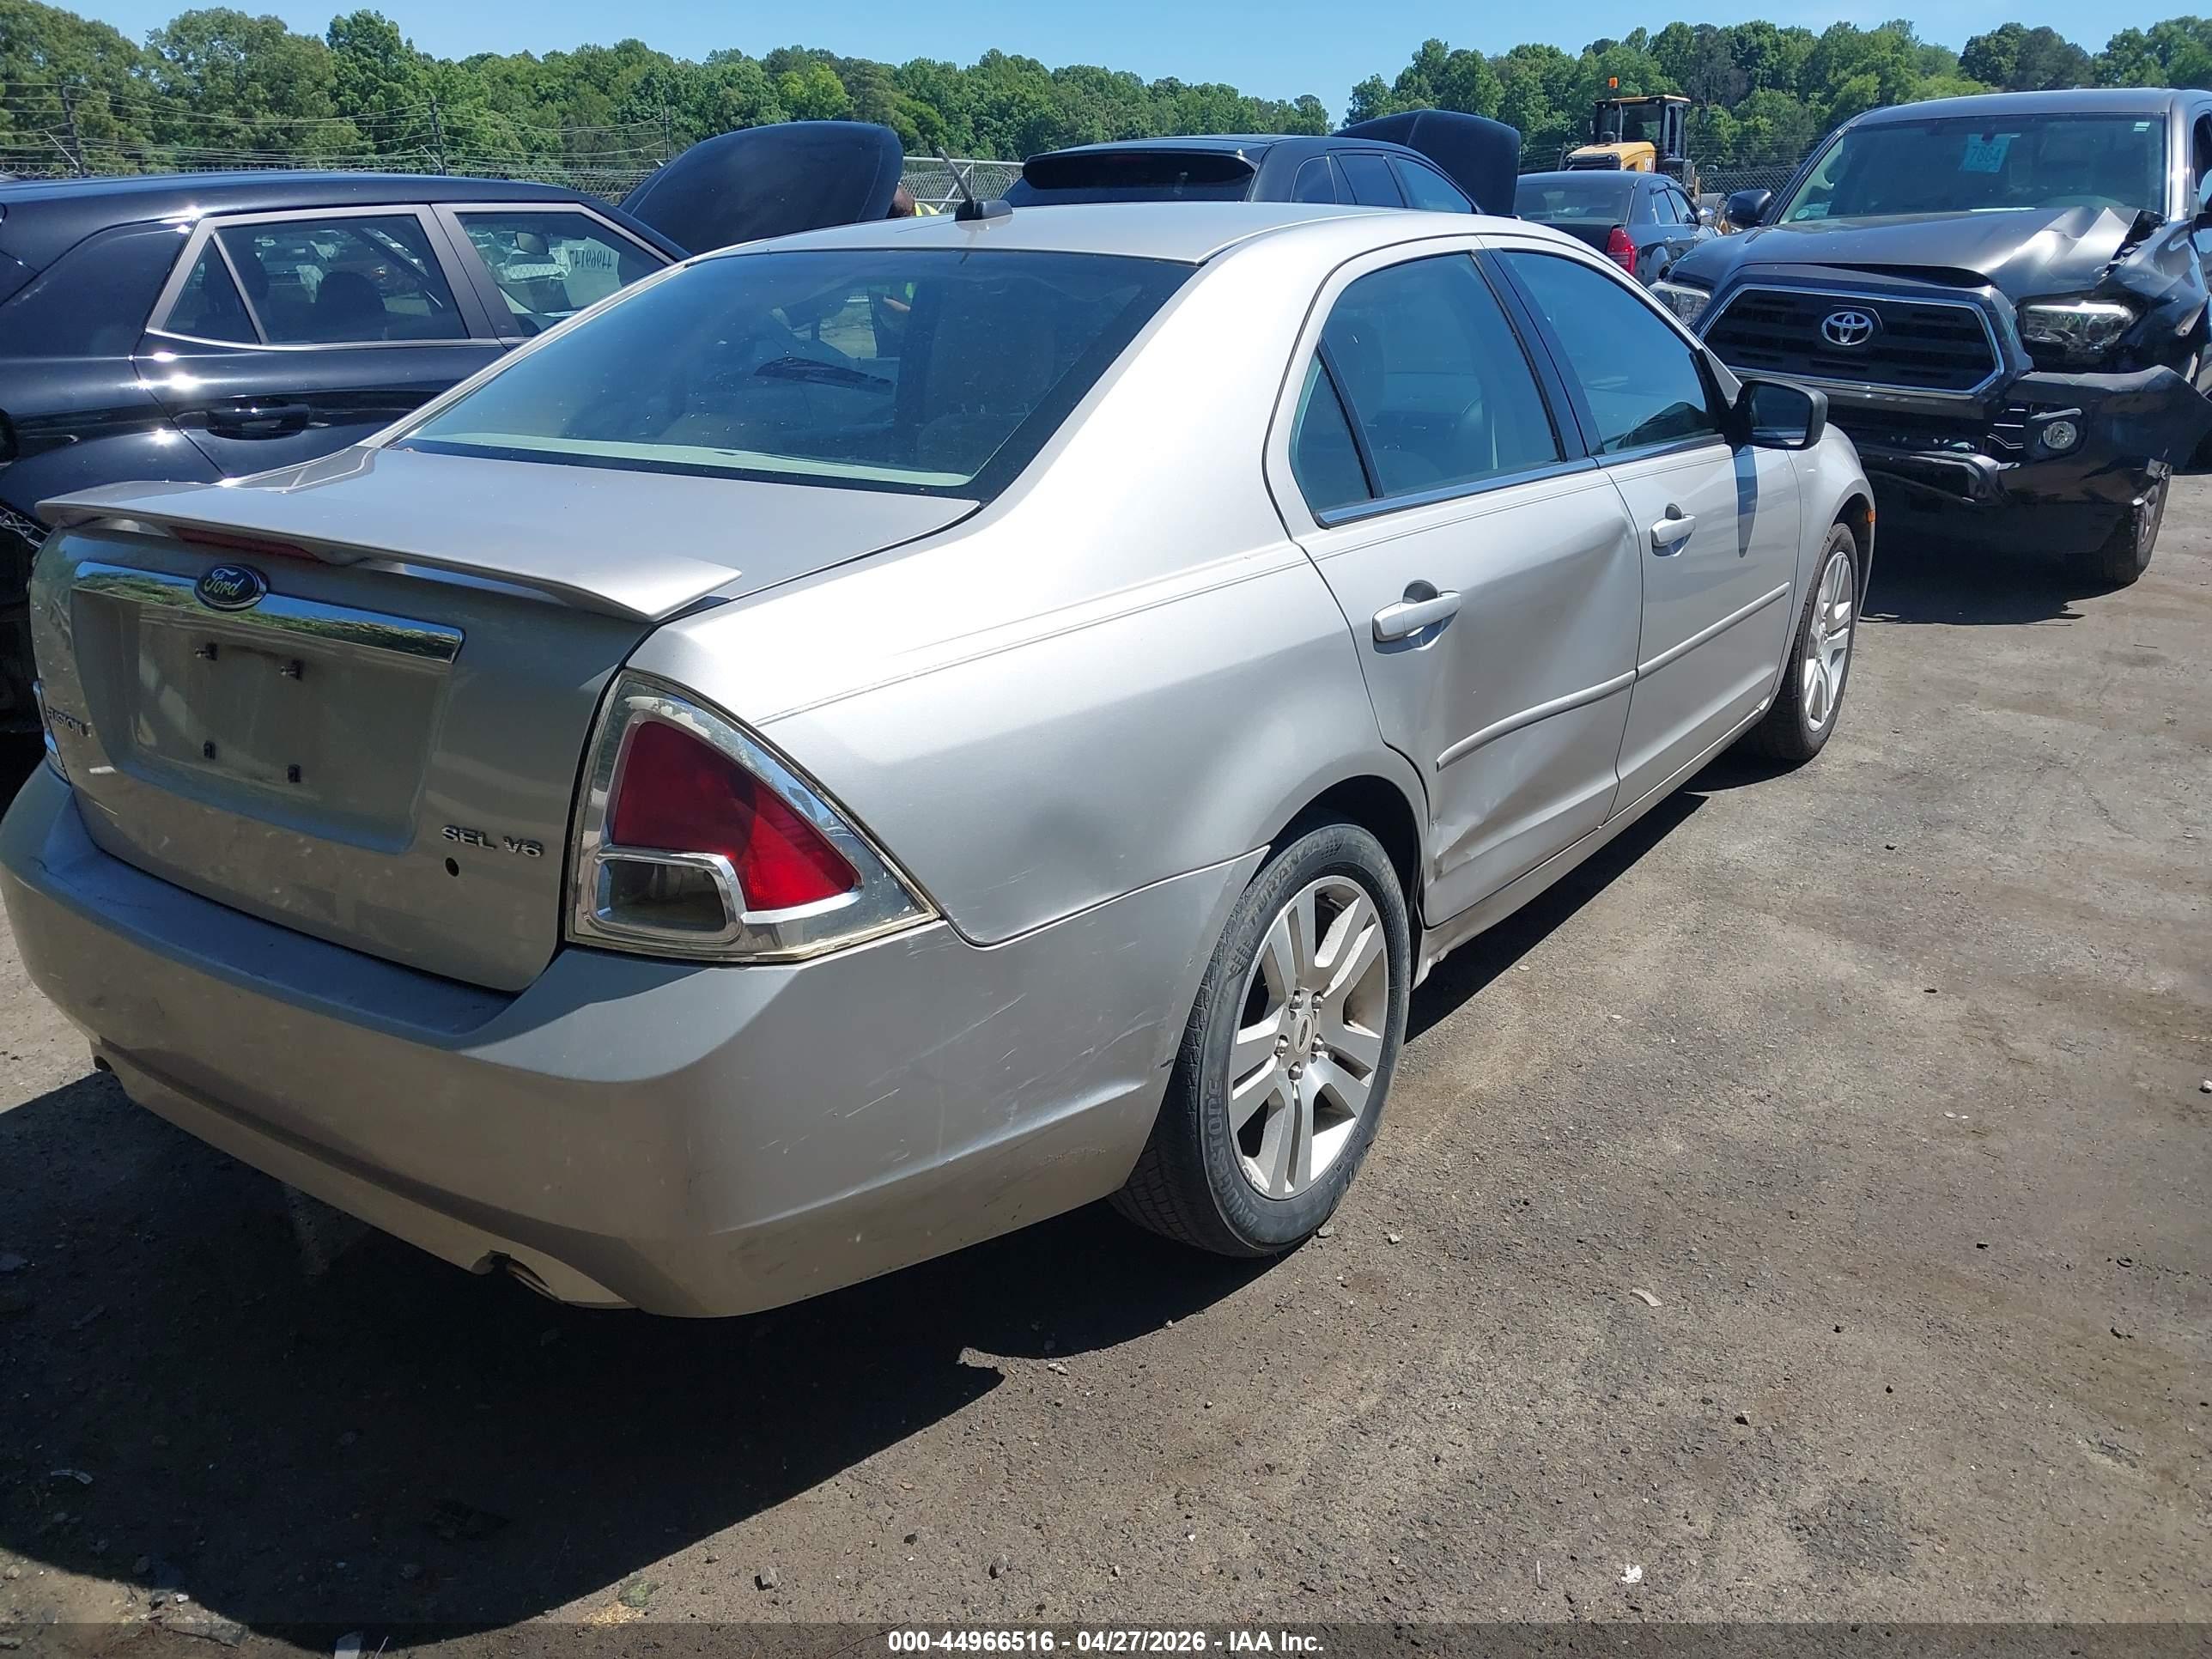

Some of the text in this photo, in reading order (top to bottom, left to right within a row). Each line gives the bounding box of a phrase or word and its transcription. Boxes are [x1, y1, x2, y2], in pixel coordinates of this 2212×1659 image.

[204, 568, 244, 596] Ford
[441, 825, 544, 858] SEL V6
[1207, 1079, 1260, 1231] BRIDGESTONE
